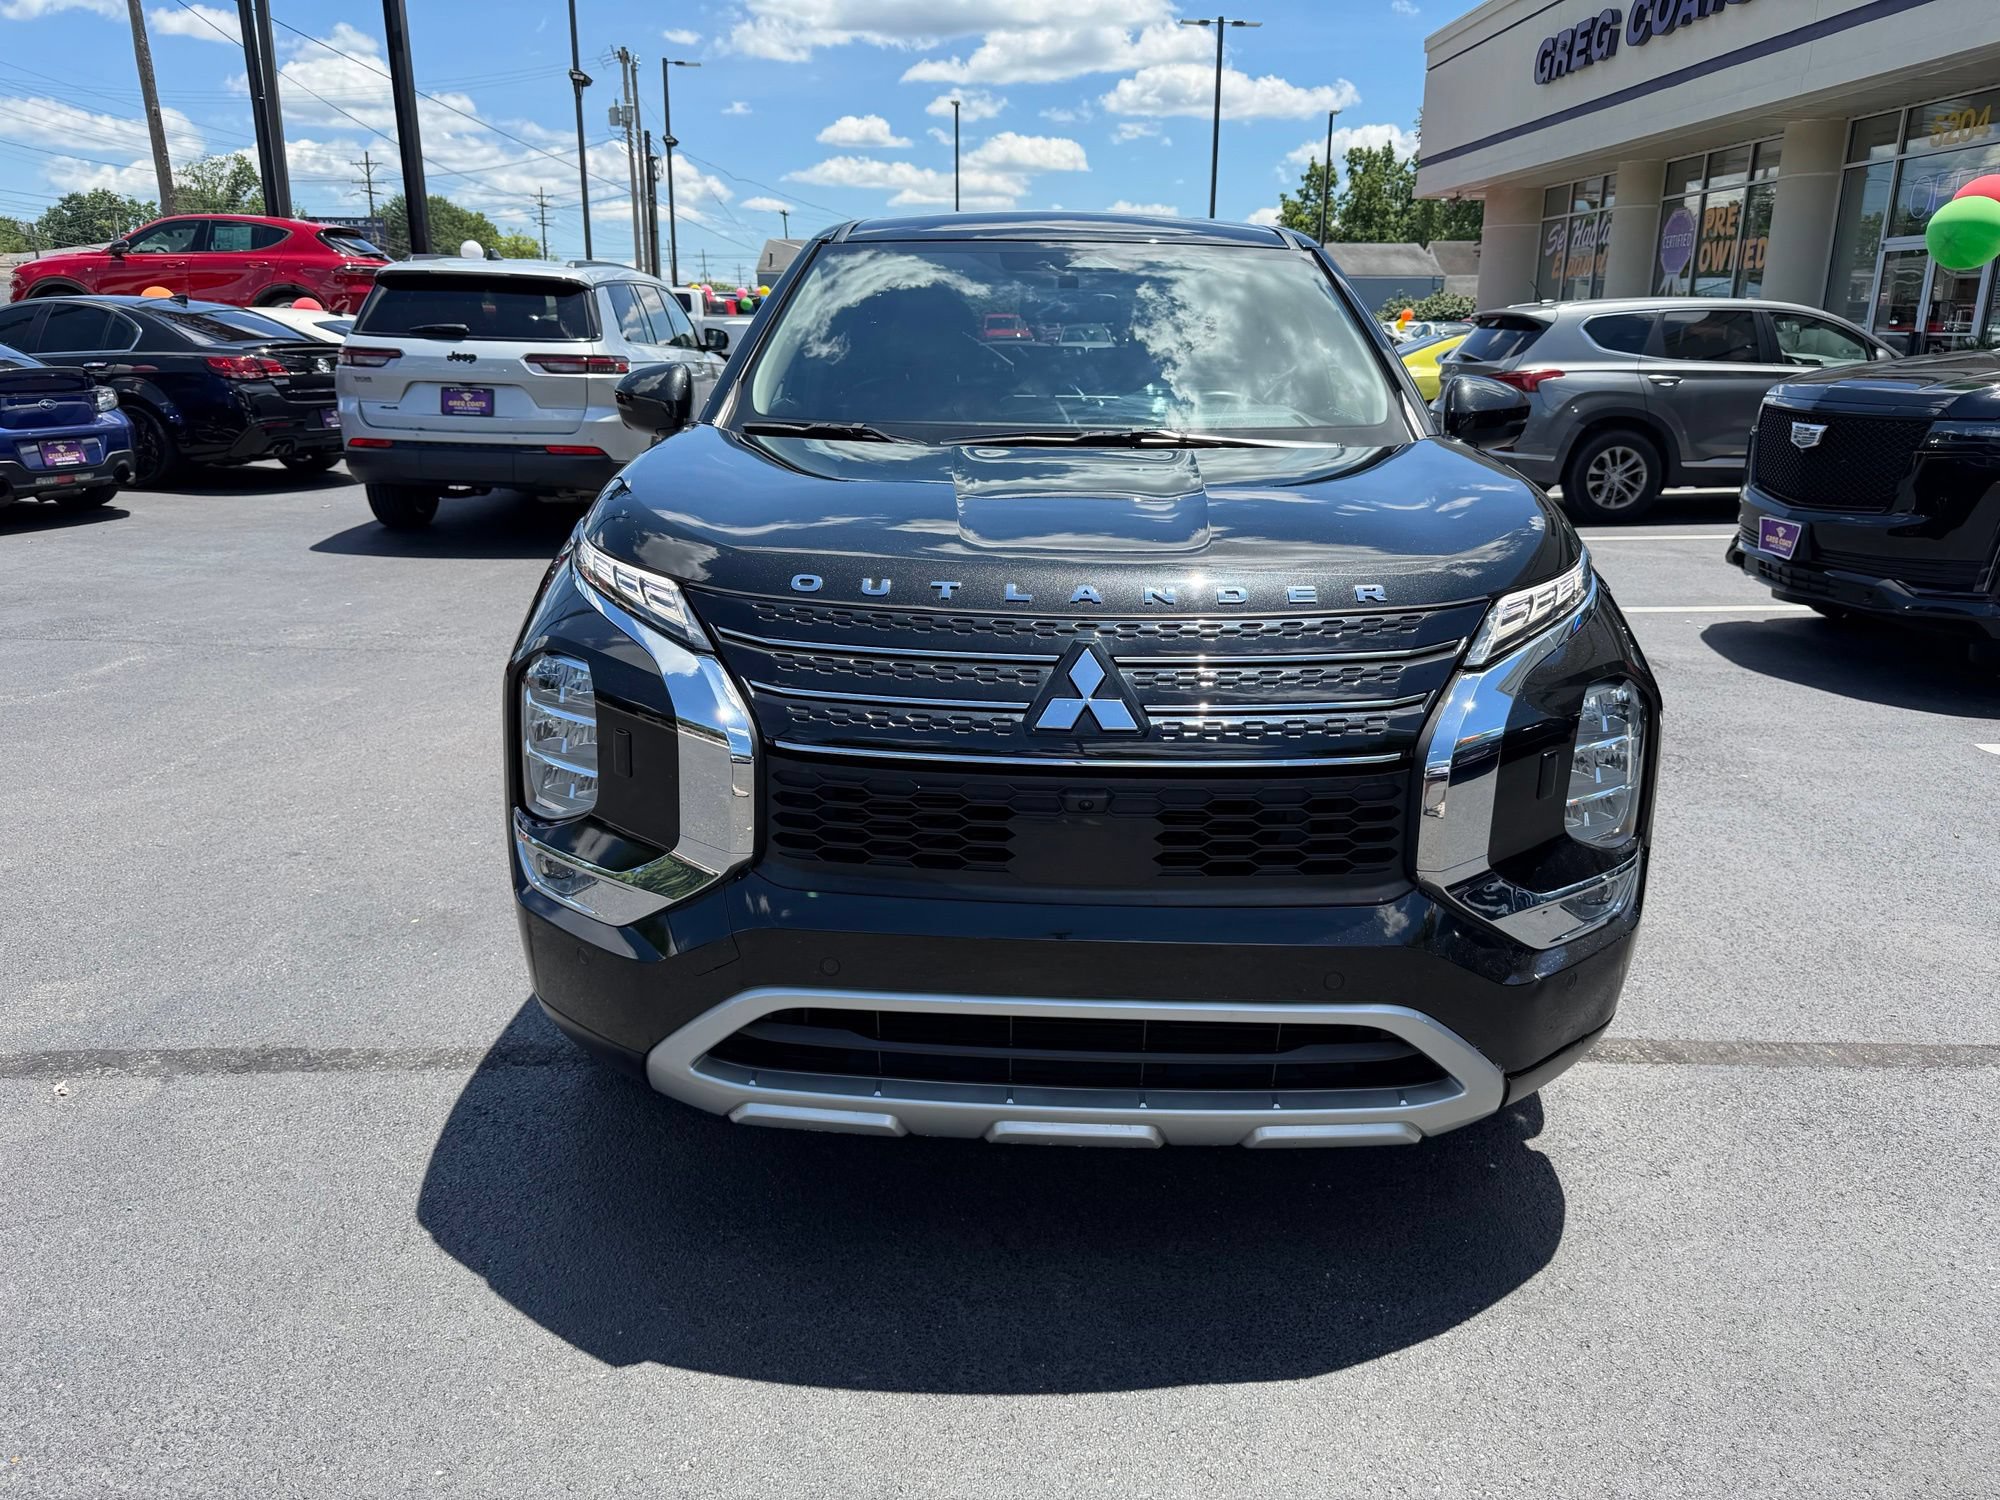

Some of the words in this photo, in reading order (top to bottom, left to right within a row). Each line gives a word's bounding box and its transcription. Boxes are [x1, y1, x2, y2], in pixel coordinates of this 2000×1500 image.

[1534, 8, 1622, 84] GREG
[1930, 104, 1992, 148] 5204
[1703, 206, 1738, 238] PRE
[1545, 223, 1566, 257] Se
[1662, 232, 1692, 249] CERTIFIED
[1698, 236, 1769, 272] OWNED
[447, 350, 477, 364] Jeep
[791, 573, 1388, 603] OUTLANDER
